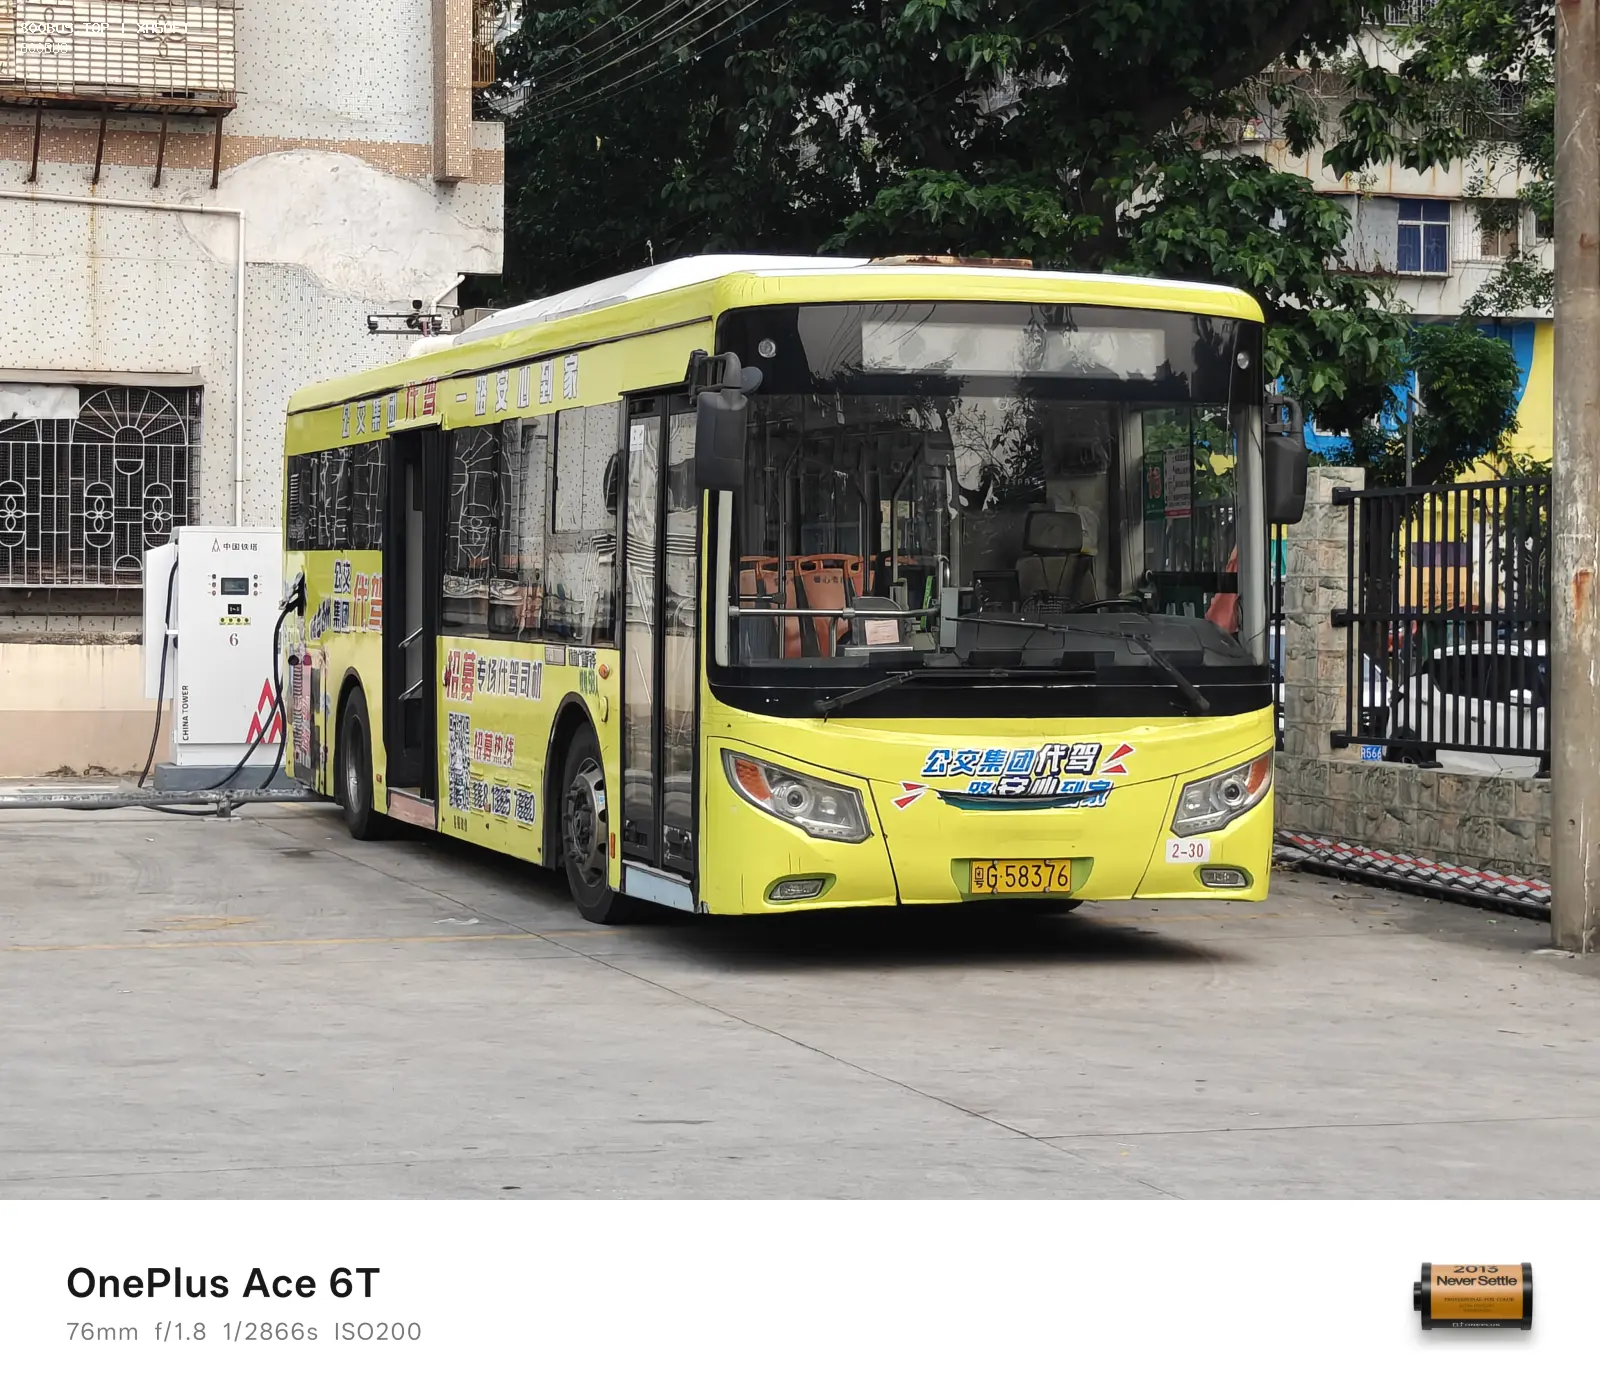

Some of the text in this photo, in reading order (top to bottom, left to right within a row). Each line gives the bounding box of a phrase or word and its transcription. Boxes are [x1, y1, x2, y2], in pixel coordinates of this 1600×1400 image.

[456, 353, 579, 416] 一路安心到家
[223, 542, 258, 551] 中国铁塔
[334, 560, 351, 594] 公交
[229, 632, 239, 647] 6
[181, 685, 190, 741] CHINA TOWER
[922, 743, 1102, 777] 公交集团代驾
[1171, 842, 1205, 859] 2-30
